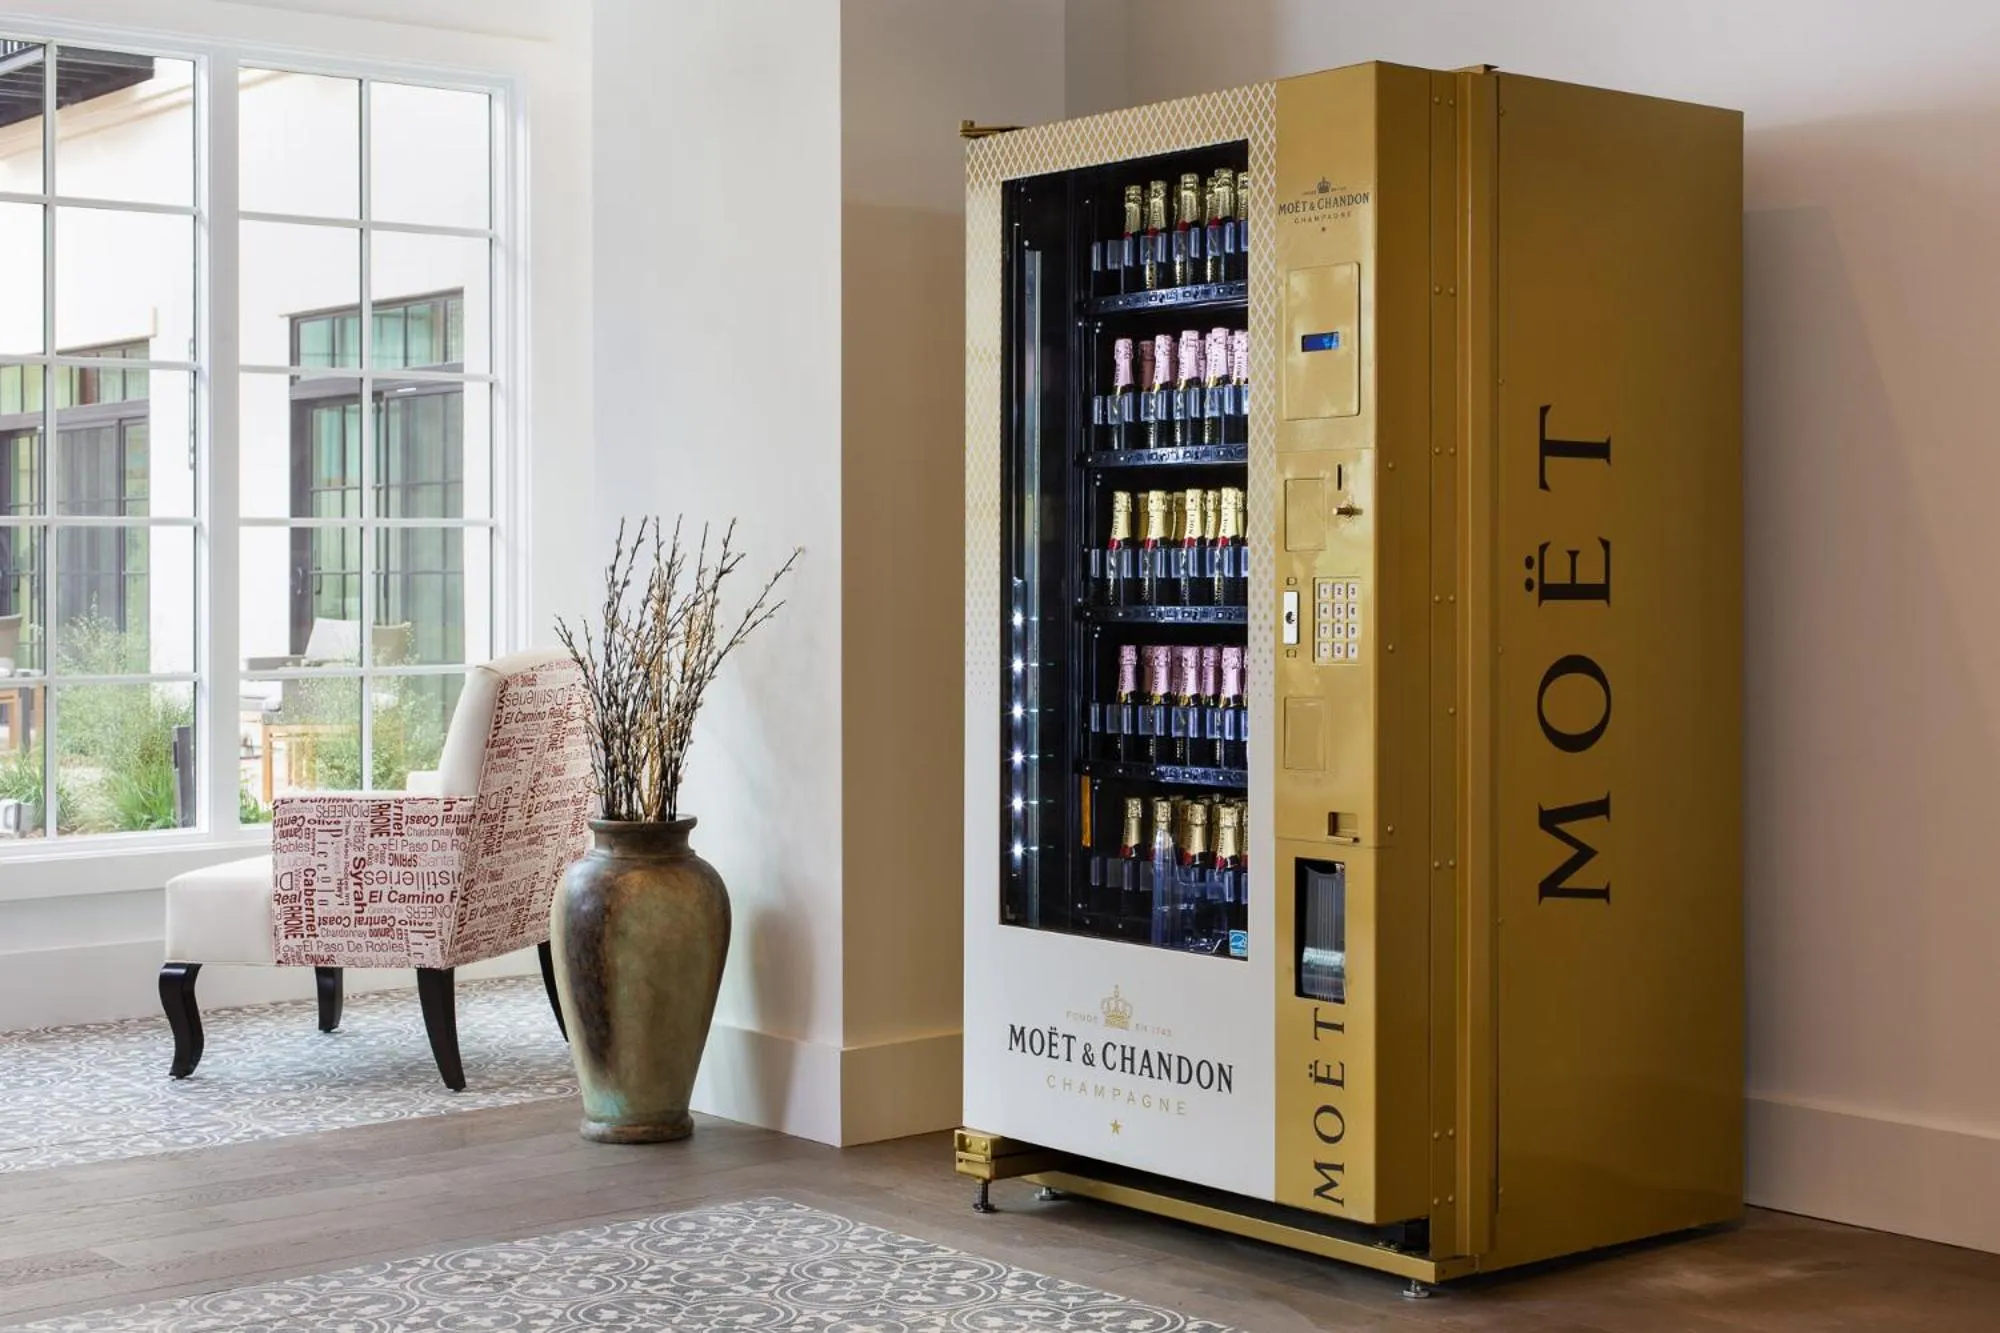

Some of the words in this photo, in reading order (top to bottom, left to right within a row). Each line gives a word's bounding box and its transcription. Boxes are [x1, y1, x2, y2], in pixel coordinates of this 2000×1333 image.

[1309, 202, 1315, 212] &
[1317, 191, 1369, 211] CHANDON
[1294, 211, 1351, 225] CHAMPAGNE
[1524, 404, 1611, 905] MOËT
[315, 803, 370, 819] PIONEERS
[405, 814, 439, 828] Coast
[387, 838, 398, 851] El
[401, 839, 429, 853] Paso
[431, 839, 447, 852] De
[349, 856, 368, 914] Syrah
[303, 867, 319, 939] Cabernet
[368, 890, 383, 904] El
[387, 890, 445, 904] Camino
[283, 905, 304, 940] RHONE
[317, 915, 352, 929] Coast
[354, 915, 396, 929] Central
[316, 941, 344, 953] Paso
[347, 941, 363, 953] De
[365, 940, 405, 953] Robles
[1008, 1024, 1077, 1062] MOËT
[1082, 1042, 1096, 1067] &
[1102, 1042, 1233, 1094] CHANDON
[1047, 1075, 1187, 1116] CHAMPAGNE
[1309, 1007, 1345, 1207] MOËT
